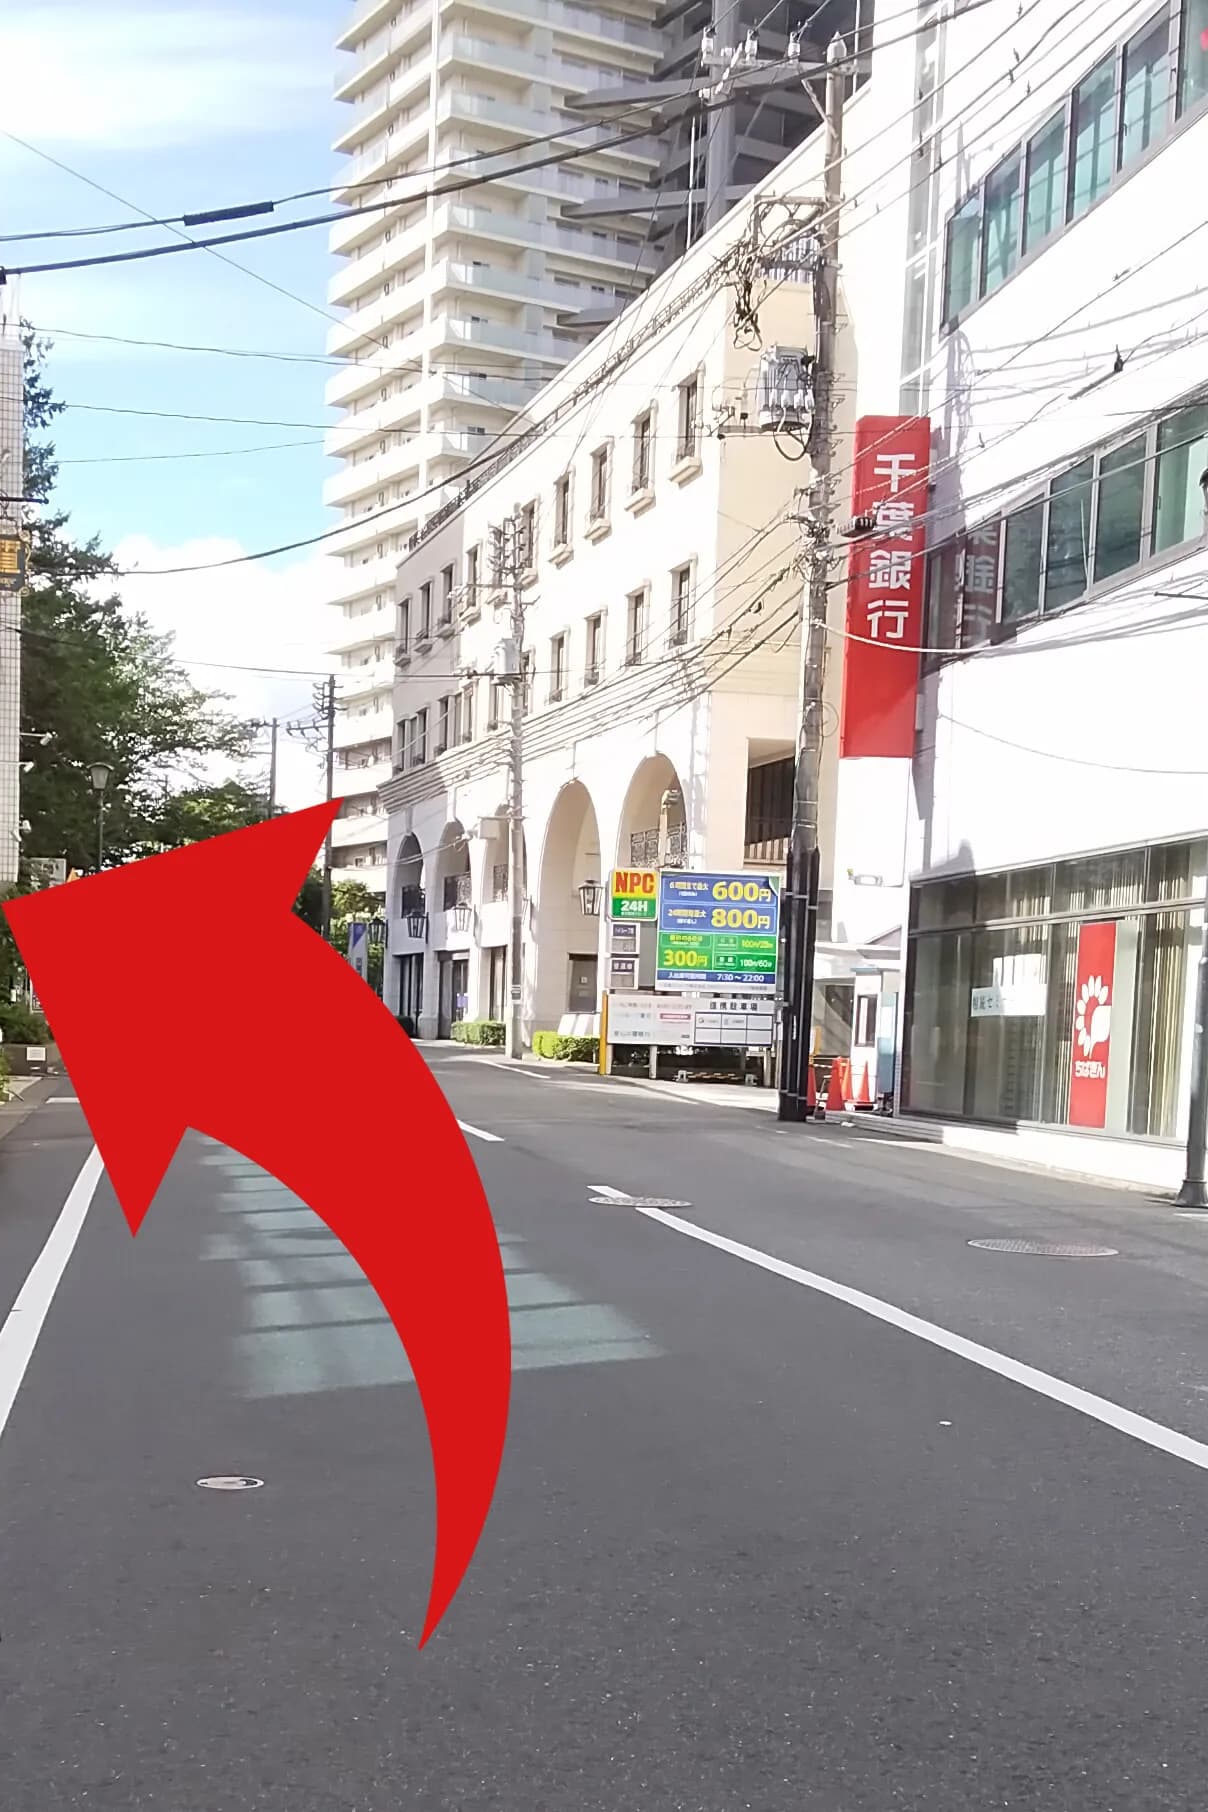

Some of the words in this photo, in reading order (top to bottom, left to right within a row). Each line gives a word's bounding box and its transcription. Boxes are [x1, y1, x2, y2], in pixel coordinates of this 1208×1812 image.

[867, 453, 917, 639] 千葉銀行
[615, 872, 654, 893] NPC
[712, 881, 772, 902] 600円
[620, 900, 648, 912] 24H
[711, 908, 771, 929] 800円
[663, 949, 708, 967] 300円
